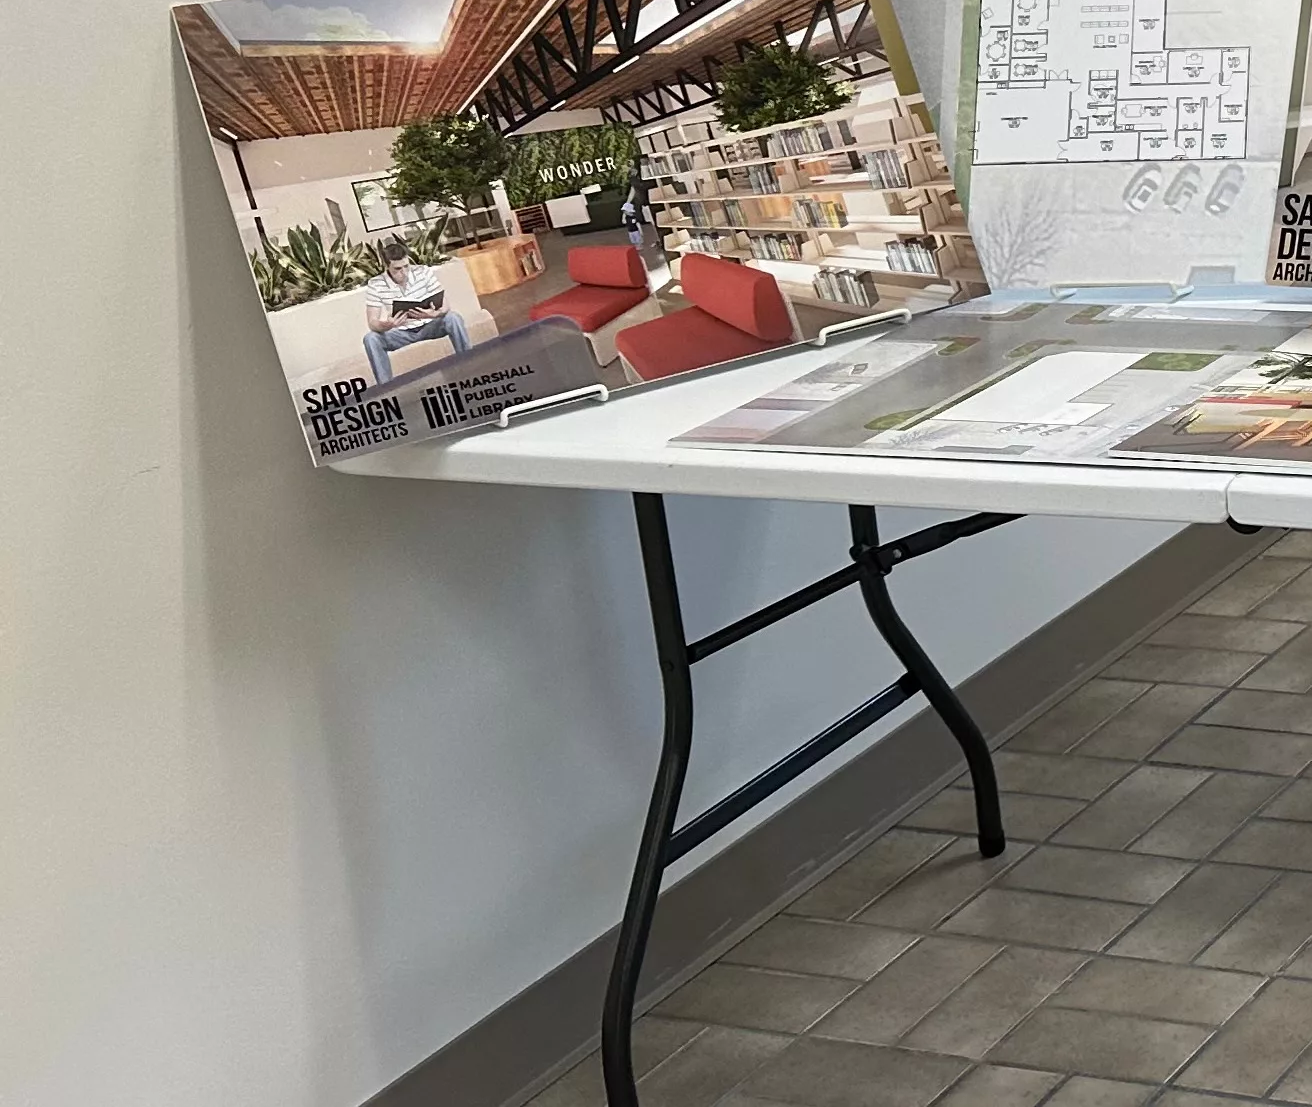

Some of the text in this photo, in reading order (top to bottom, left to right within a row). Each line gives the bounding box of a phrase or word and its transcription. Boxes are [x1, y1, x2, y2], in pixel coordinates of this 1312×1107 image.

[538, 156, 617, 183] WONDER
[459, 364, 535, 391] MARSHALL
[464, 382, 518, 404] PUBLIC
[302, 377, 368, 414] SAPP
[310, 395, 404, 441] DESIGN
[320, 422, 409, 457] ARCHITECTS
